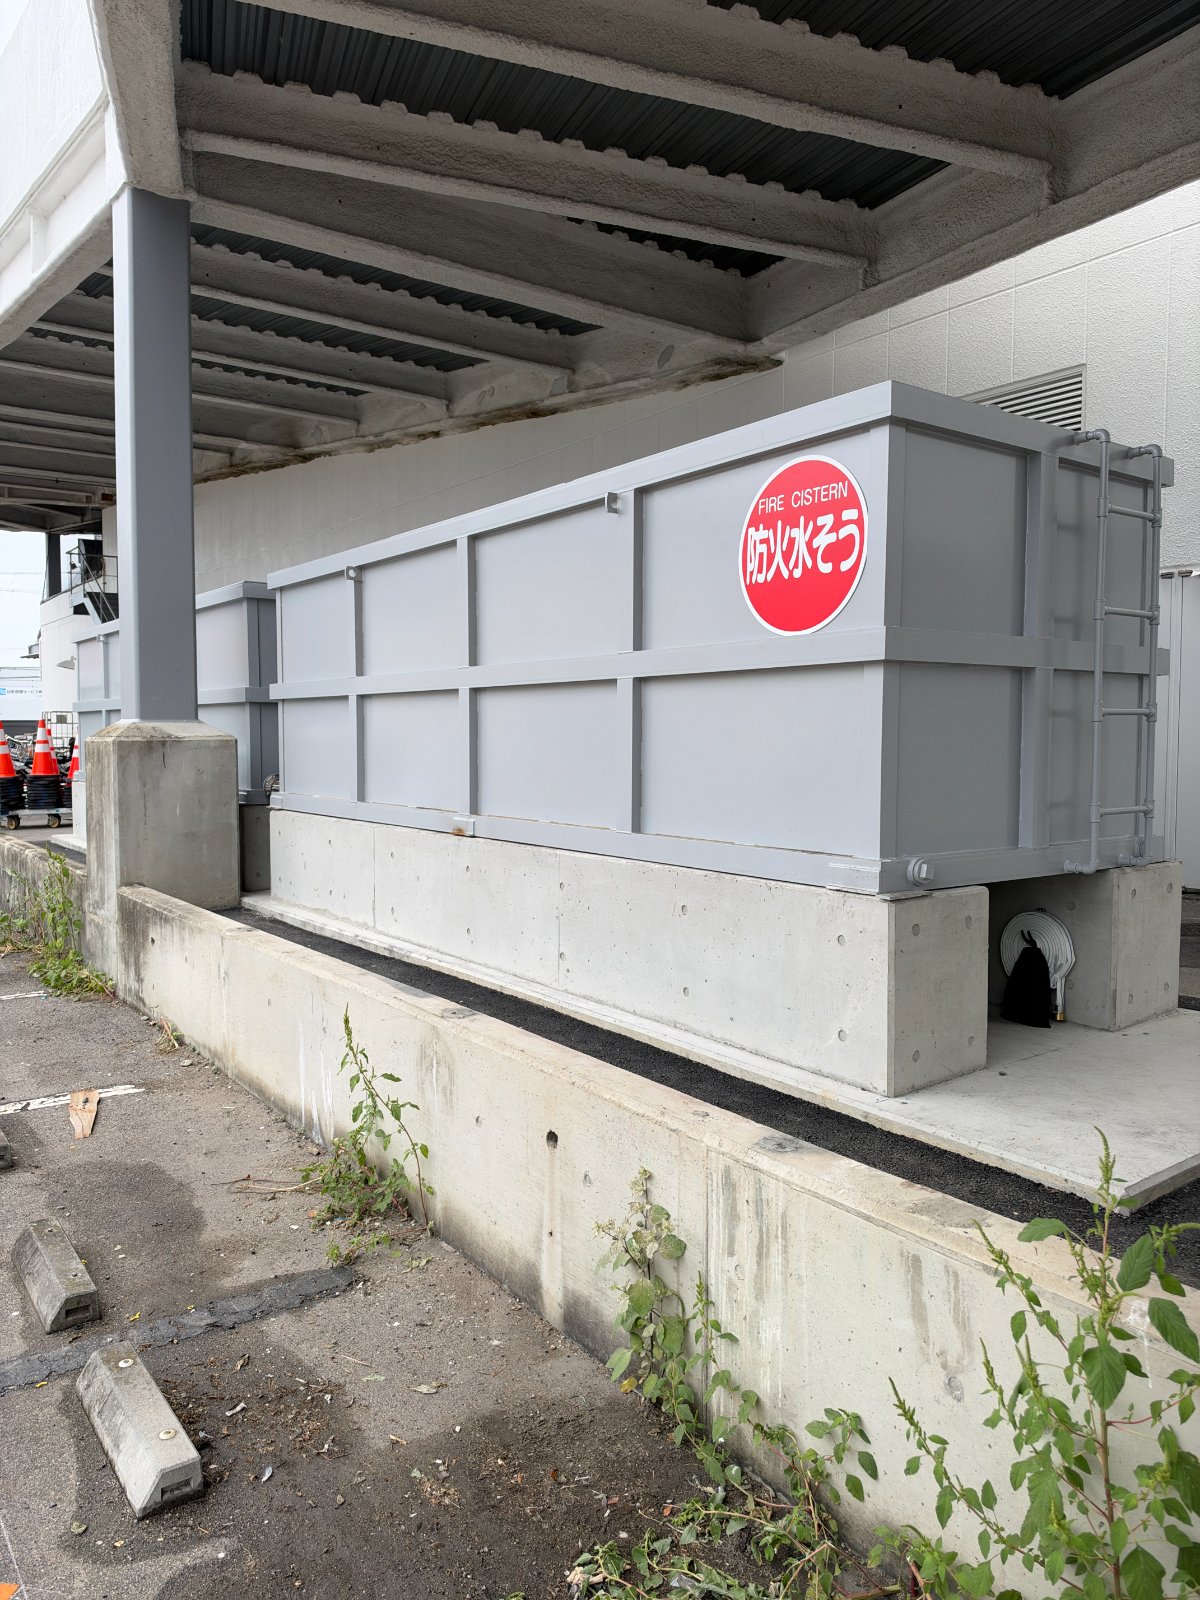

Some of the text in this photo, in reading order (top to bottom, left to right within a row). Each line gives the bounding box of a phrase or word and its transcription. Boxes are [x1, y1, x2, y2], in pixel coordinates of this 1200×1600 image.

[758, 480, 848, 515] FIRE CISTERN
[746, 509, 860, 586] 防火水そう
